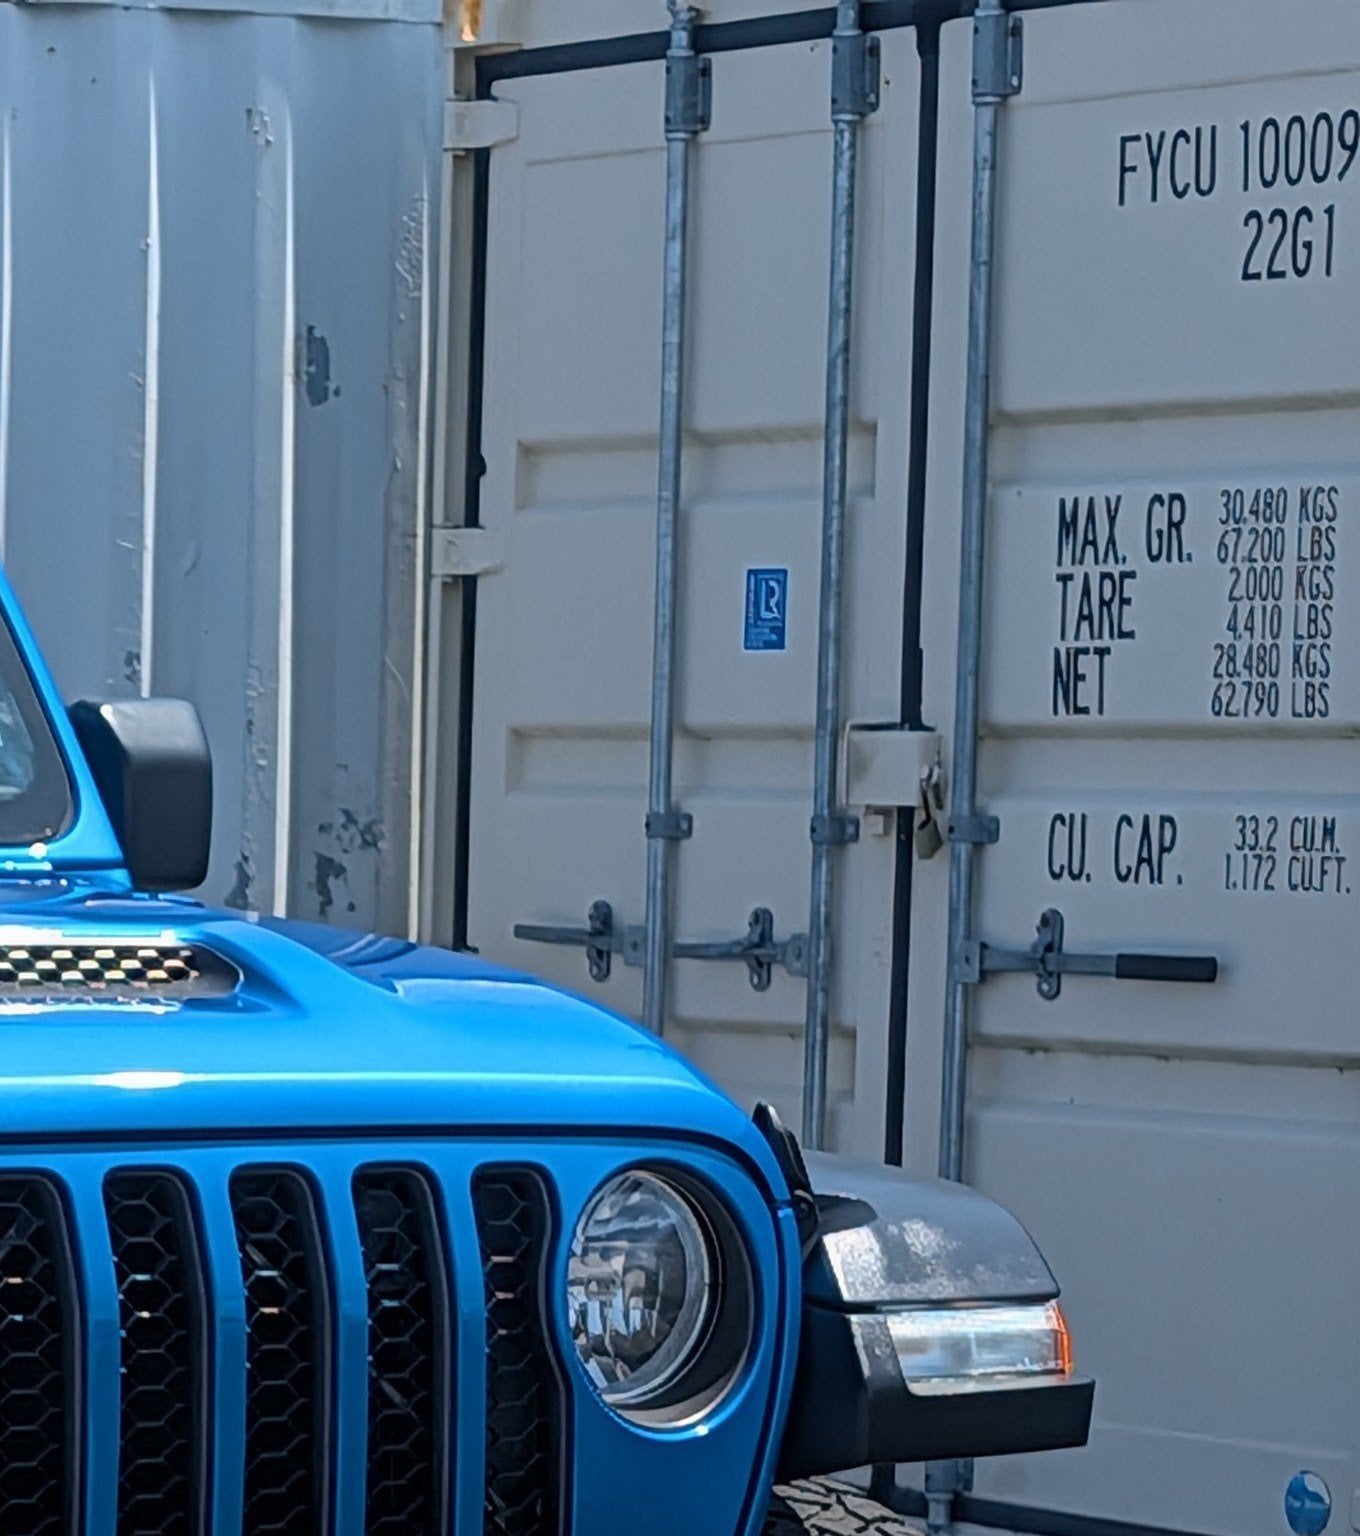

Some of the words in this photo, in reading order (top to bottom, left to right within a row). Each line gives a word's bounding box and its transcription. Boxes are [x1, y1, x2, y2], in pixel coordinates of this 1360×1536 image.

[1119, 125, 1217, 206] FYCU
[1239, 109, 1360, 193] 10009
[1241, 204, 1335, 281] 22G1
[1057, 495, 1127, 567] MAX.
[1146, 493, 1192, 563] GR.
[1218, 487, 1288, 525] 30.480
[1299, 485, 1339, 523] KGS
[1217, 526, 1285, 564] 67.200
[1297, 525, 1336, 562] LBS
[1055, 570, 1137, 641] TARE
[1295, 564, 1335, 601] KGS
[1226, 603, 1283, 641] 4.410
[1293, 603, 1333, 640] LBS
[1053, 647, 1111, 716] NET
[1213, 642, 1281, 679] 28.480
[1292, 642, 1331, 679] KGS
[1291, 681, 1330, 718] LBS
[1047, 813, 1092, 883] CU.
[1114, 813, 1183, 885] CAP.
[1234, 815, 1279, 852] 33.2
